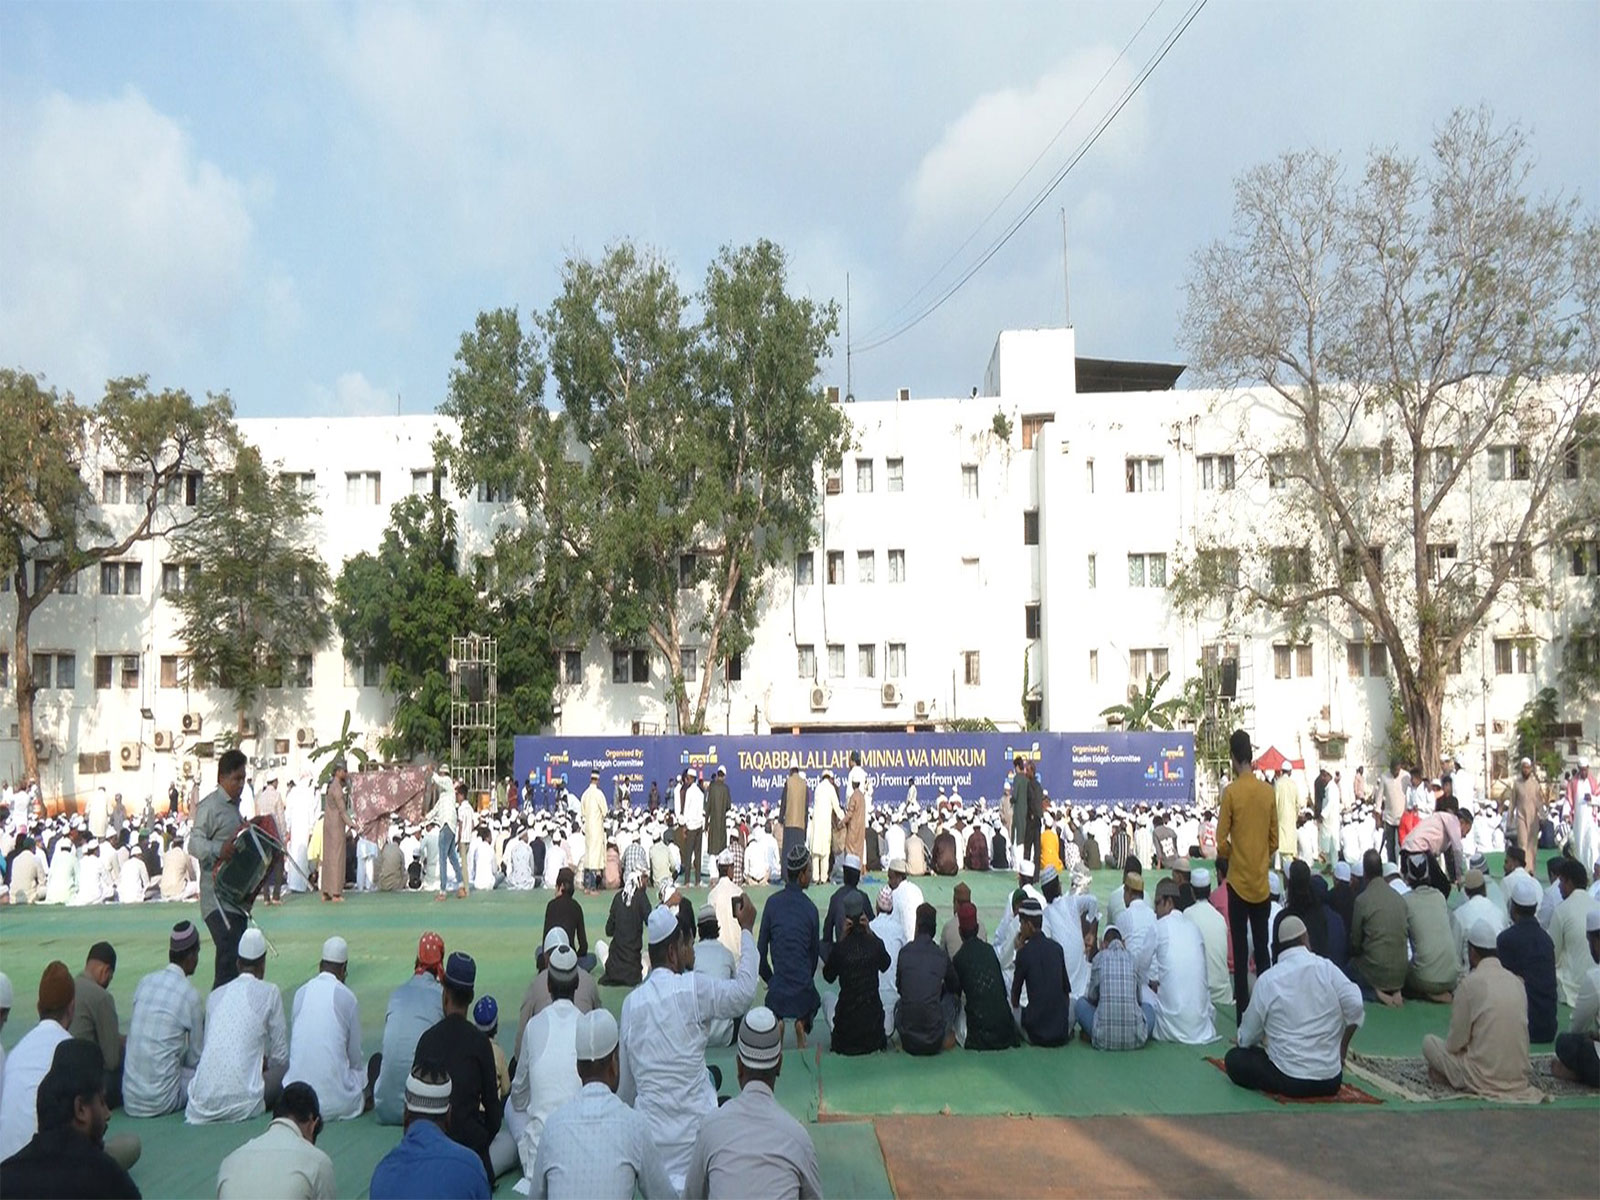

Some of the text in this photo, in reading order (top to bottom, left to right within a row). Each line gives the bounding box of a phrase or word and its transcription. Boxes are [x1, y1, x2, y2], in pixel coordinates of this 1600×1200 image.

[605, 748, 644, 759] Organised By:
[1072, 745, 1100, 755] Organised
[572, 759, 592, 767] Muslim
[613, 759, 644, 767] Committee
[737, 748, 986, 772] TAQABBALALLAH MINNA WA MINKUM
[752, 775, 771, 791] May
[771, 774, 789, 788] Alla
[880, 773, 901, 786] from
[914, 773, 931, 786] and
[931, 772, 953, 786] from
[954, 772, 972, 787] you!
[1073, 779, 1098, 788] 400/2022
